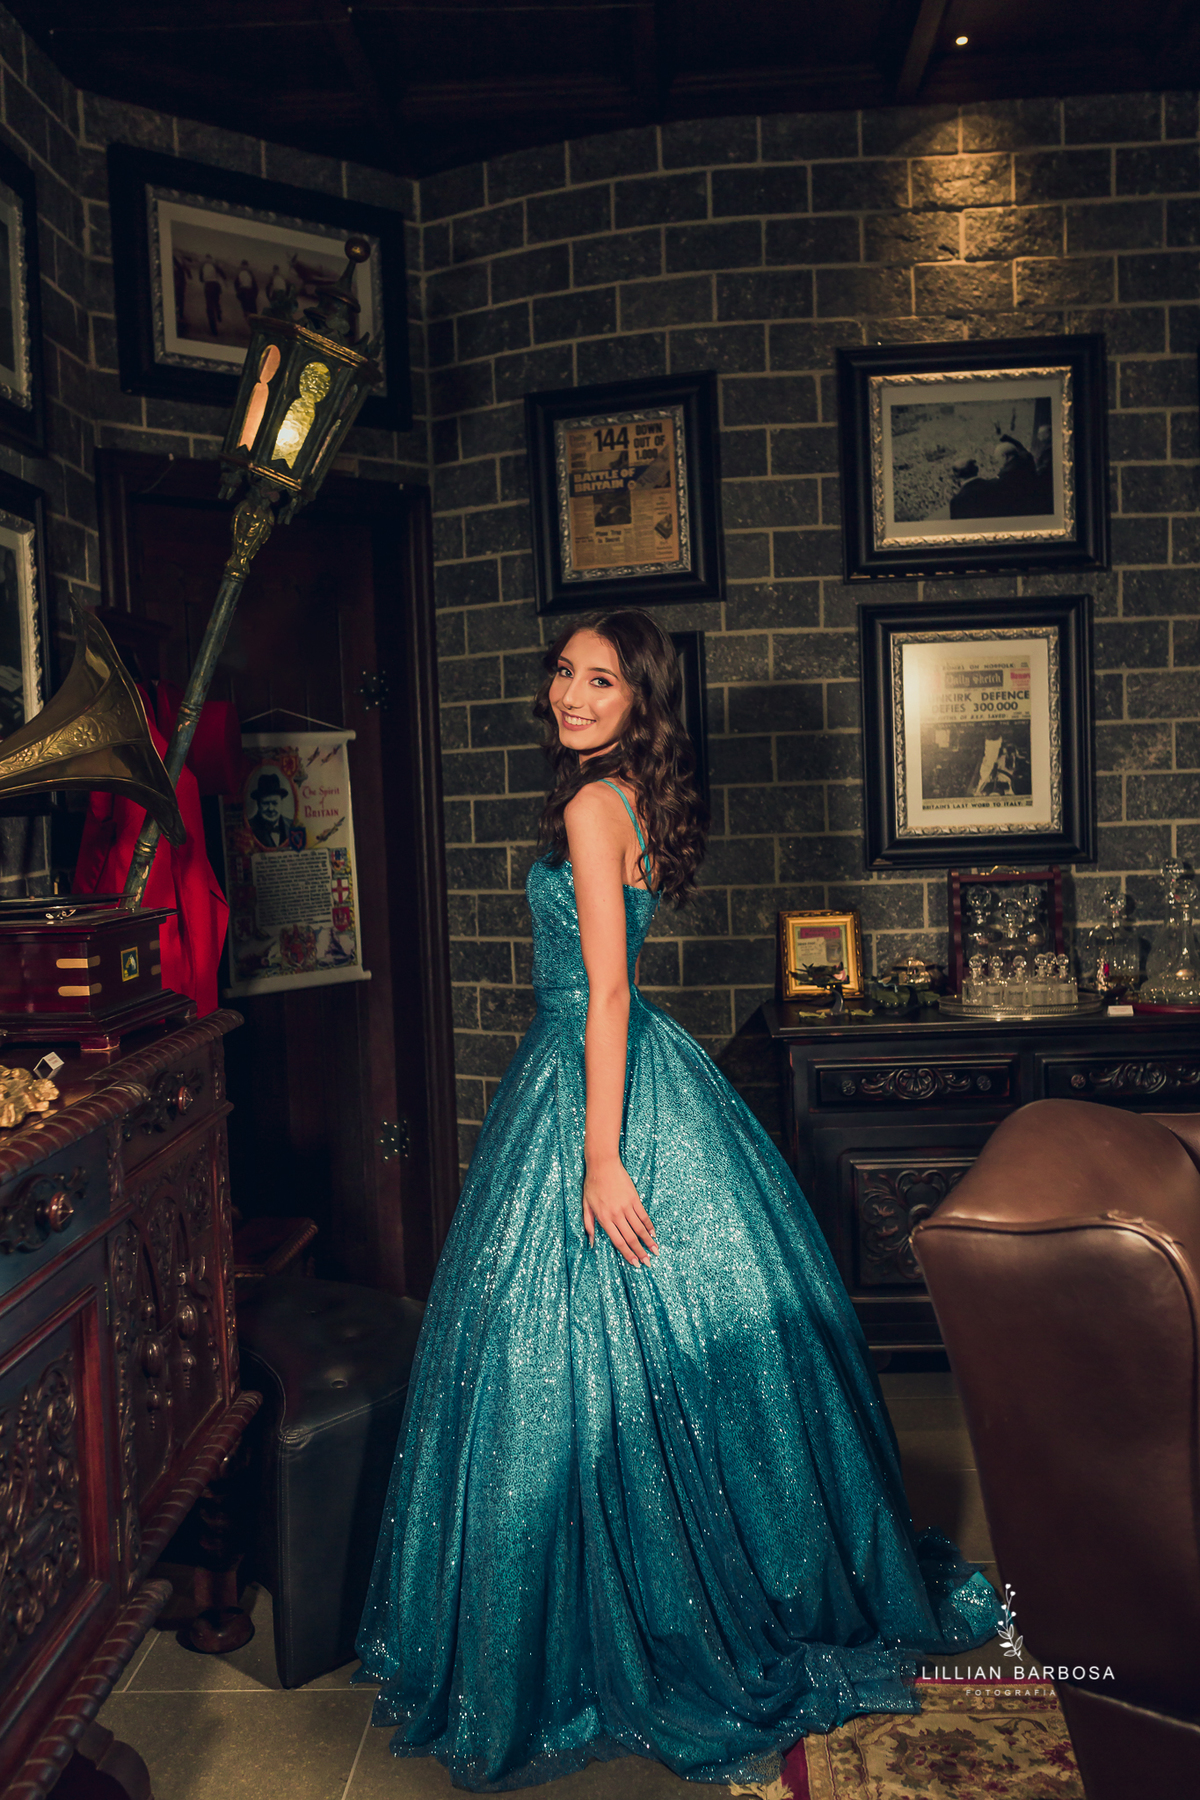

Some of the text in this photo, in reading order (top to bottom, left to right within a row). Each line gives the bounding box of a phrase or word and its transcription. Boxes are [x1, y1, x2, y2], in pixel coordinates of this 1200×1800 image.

[636, 423, 662, 436] DOWN
[594, 427, 630, 452] 144
[634, 435, 665, 448] OUT OF
[574, 467, 636, 483] BATTLE OF
[574, 479, 624, 493] BRITAIN
[981, 690, 1030, 701] DEFENCE
[931, 701, 1018, 714] DEFIES 300,000
[302, 785, 340, 799] The Spirit
